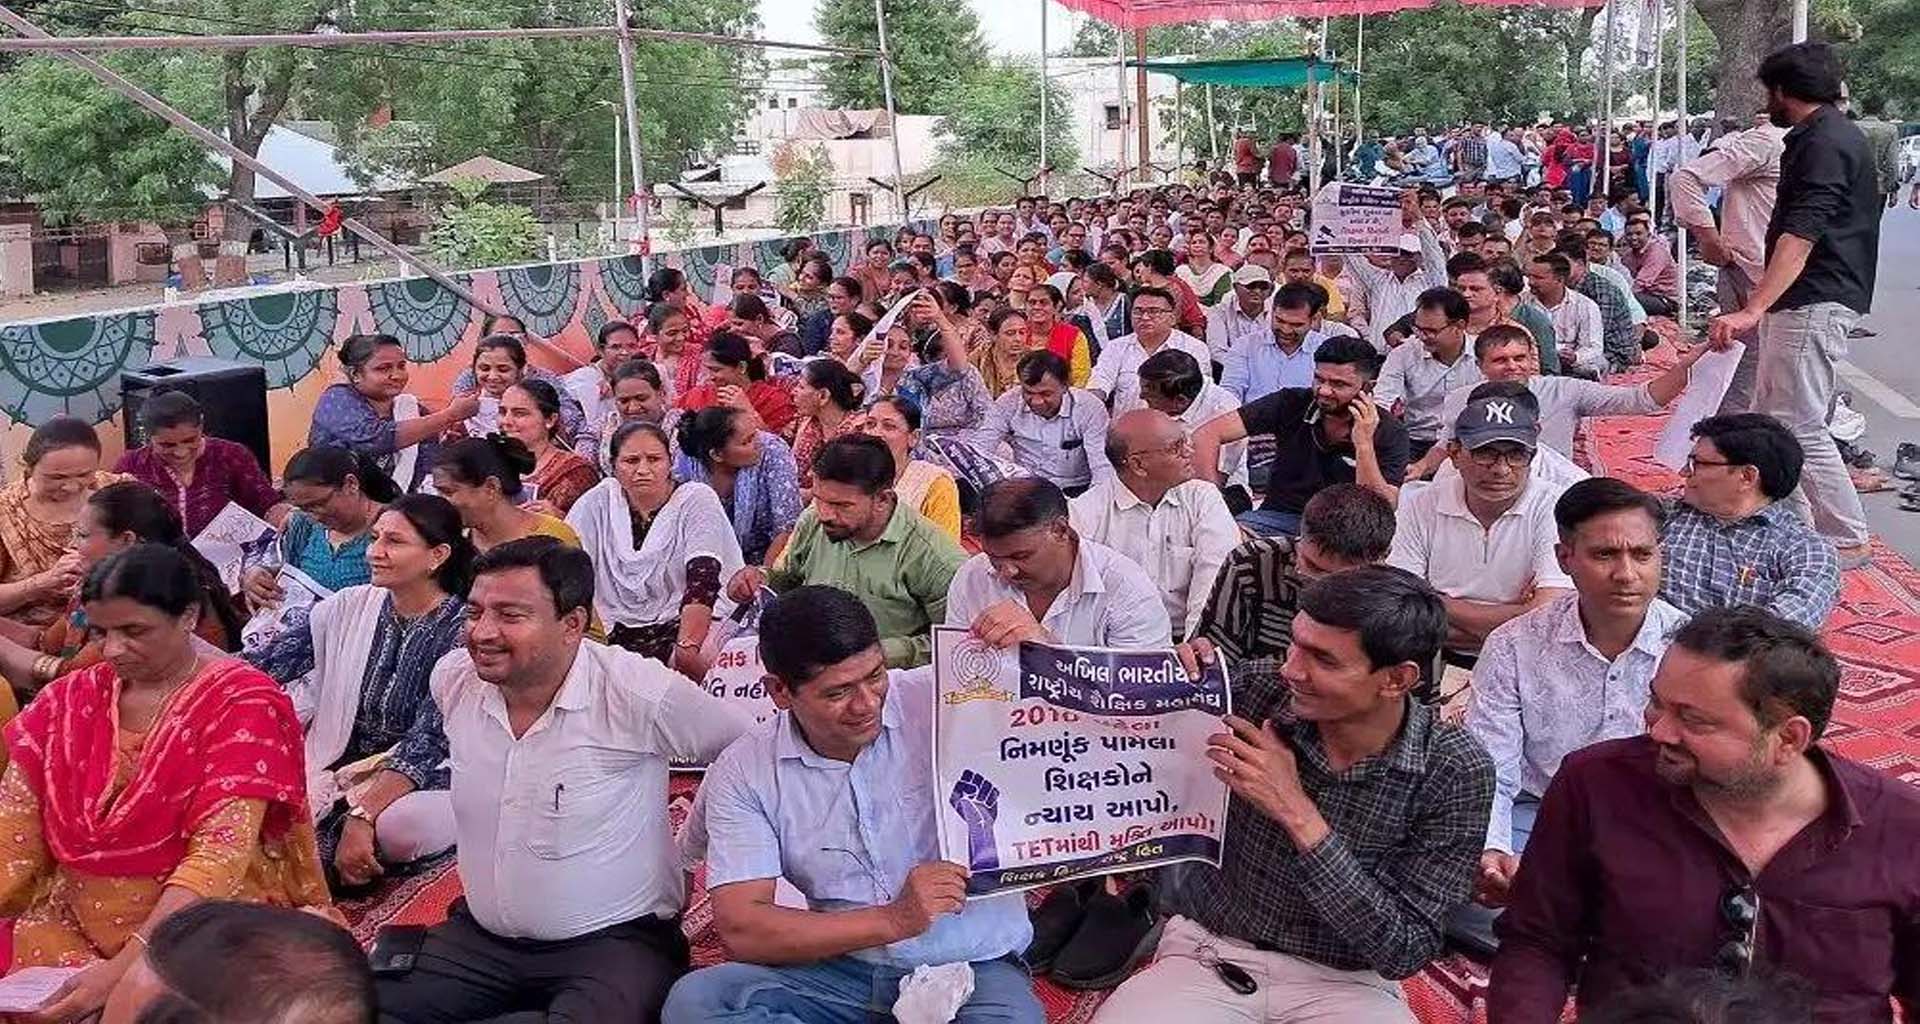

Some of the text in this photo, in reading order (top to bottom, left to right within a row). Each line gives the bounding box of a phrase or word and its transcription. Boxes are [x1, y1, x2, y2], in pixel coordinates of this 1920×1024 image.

[1056, 656, 1111, 683] અખિલ
[1000, 731, 1176, 763] નિમણૂંક પામેલા
[1045, 761, 1153, 792] શિક્ષકોને
[1024, 804, 1094, 825] ન્યાય
